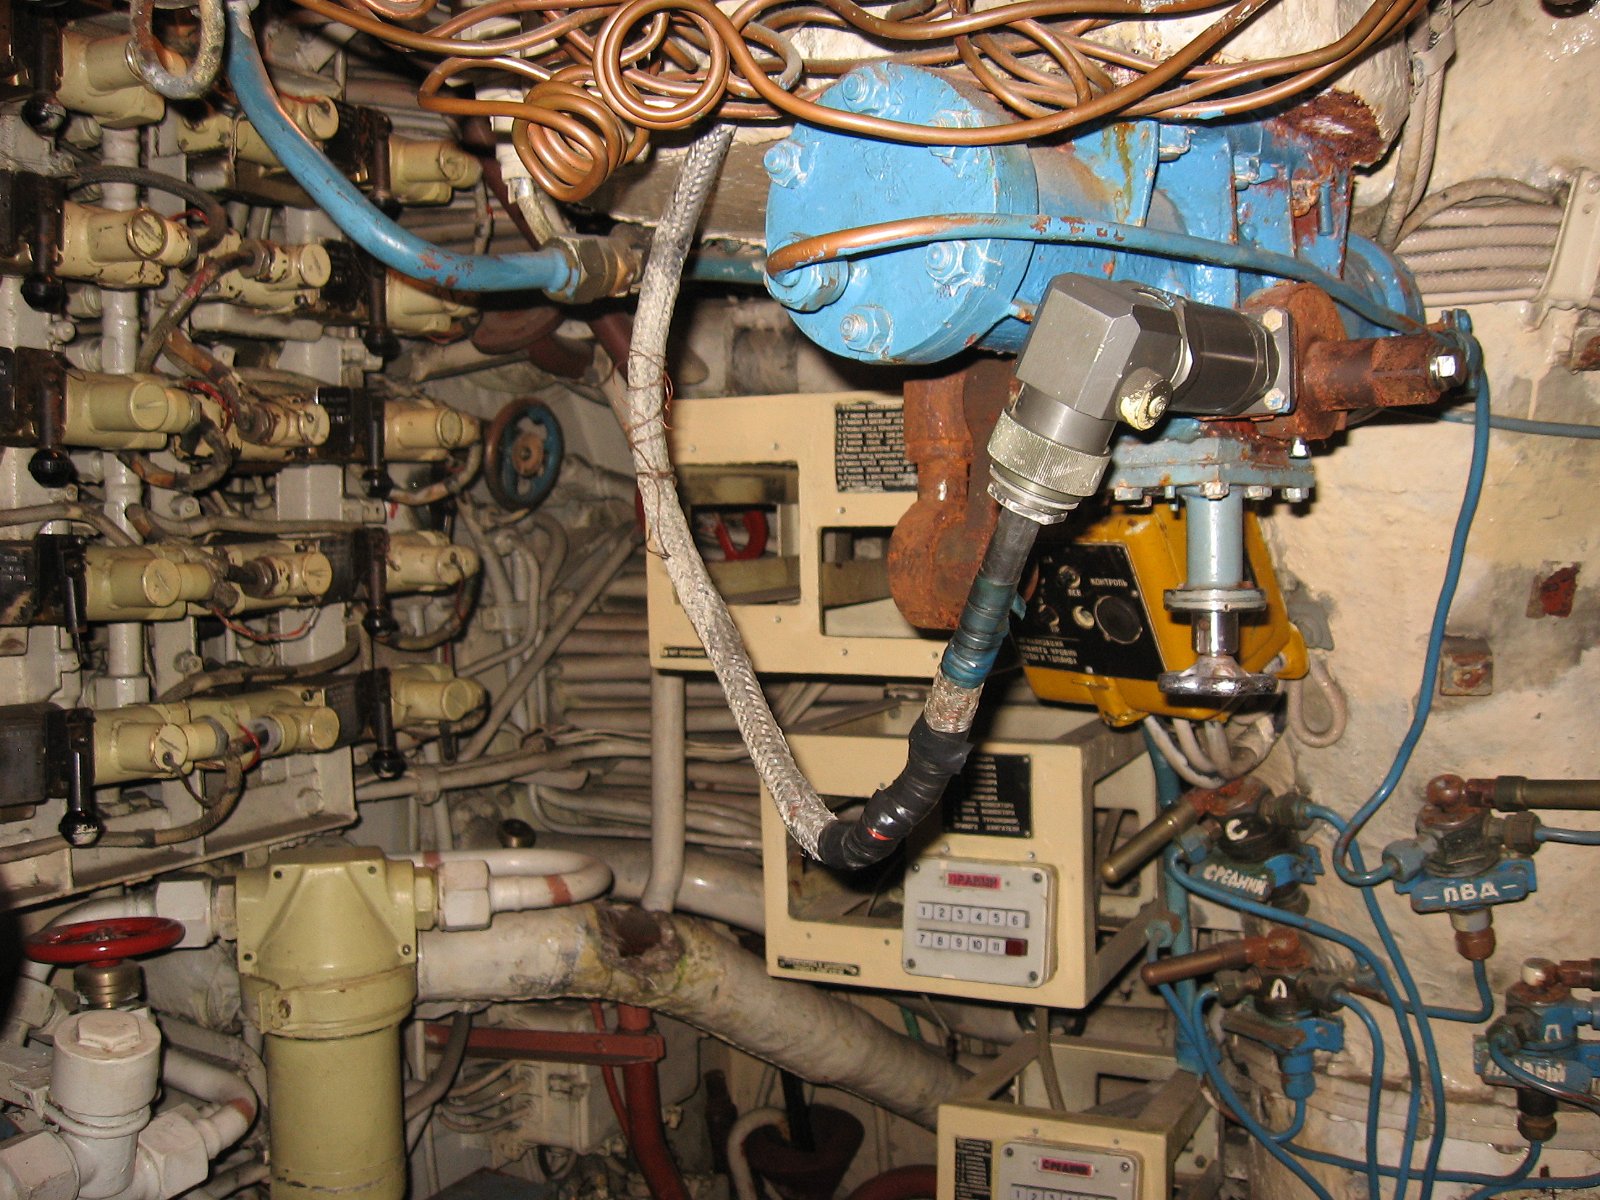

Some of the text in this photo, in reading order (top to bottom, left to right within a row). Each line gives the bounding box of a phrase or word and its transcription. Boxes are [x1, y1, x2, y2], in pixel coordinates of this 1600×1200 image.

[1090, 578, 1128, 587] КОНТРОЛЬ
[1225, 818, 1248, 841] С
[1443, 881, 1500, 903] ПВД
[921, 906, 1018, 926] 1 2 3 4 5 6
[920, 934, 999, 951] 7 8 9 10 11
[1544, 1024, 1562, 1042] П
